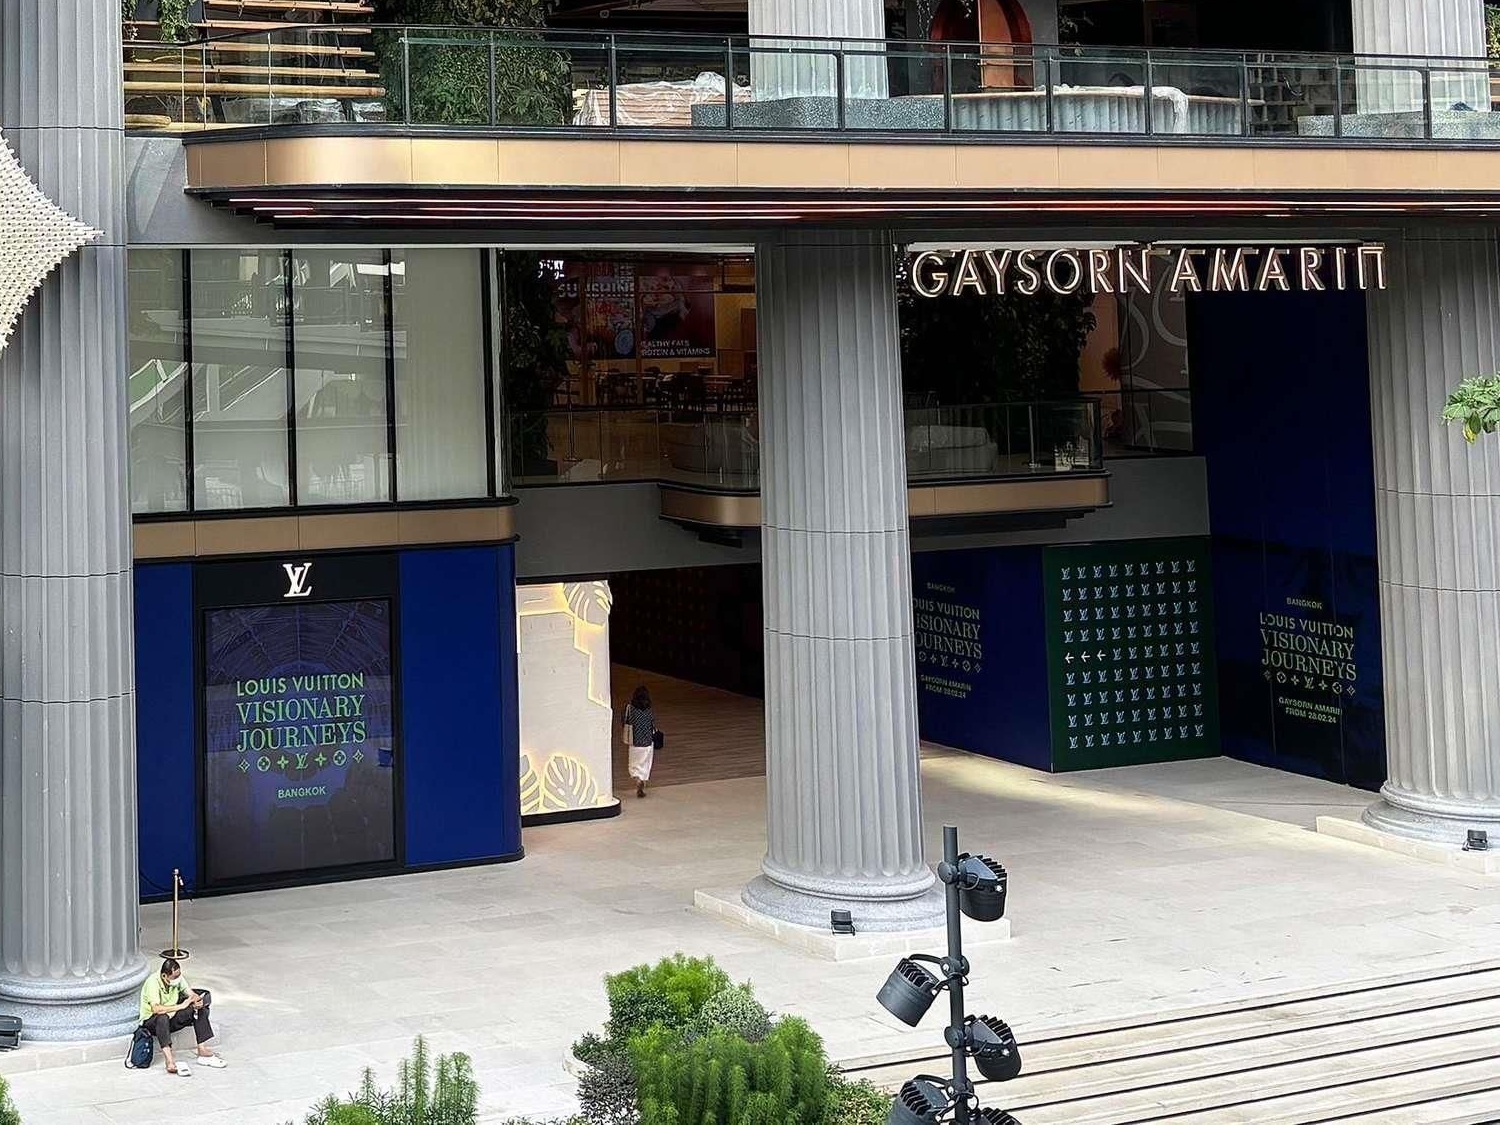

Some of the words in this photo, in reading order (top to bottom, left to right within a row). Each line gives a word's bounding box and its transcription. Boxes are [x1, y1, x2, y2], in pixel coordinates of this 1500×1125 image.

[912, 247, 1151, 298] GAYSORN
[912, 597, 934, 612] OUIS
[937, 602, 980, 620] VUITTON
[1286, 597, 1322, 610] BANGKOK
[916, 612, 981, 640] ISIONARY
[1260, 612, 1296, 630] LOUIS
[1299, 618, 1354, 639] VUITTON
[915, 630, 982, 660] OURNEYS
[1260, 628, 1354, 660] VISIONARY
[1261, 648, 1357, 681] JOURNEYS
[236, 676, 286, 697] LOUIS
[292, 672, 364, 692] VUITTON
[236, 694, 366, 725] VISIONARY
[1285, 706, 1307, 718] FROM
[235, 720, 367, 753] JOURNEYS
[277, 785, 326, 799] BANGKOK
